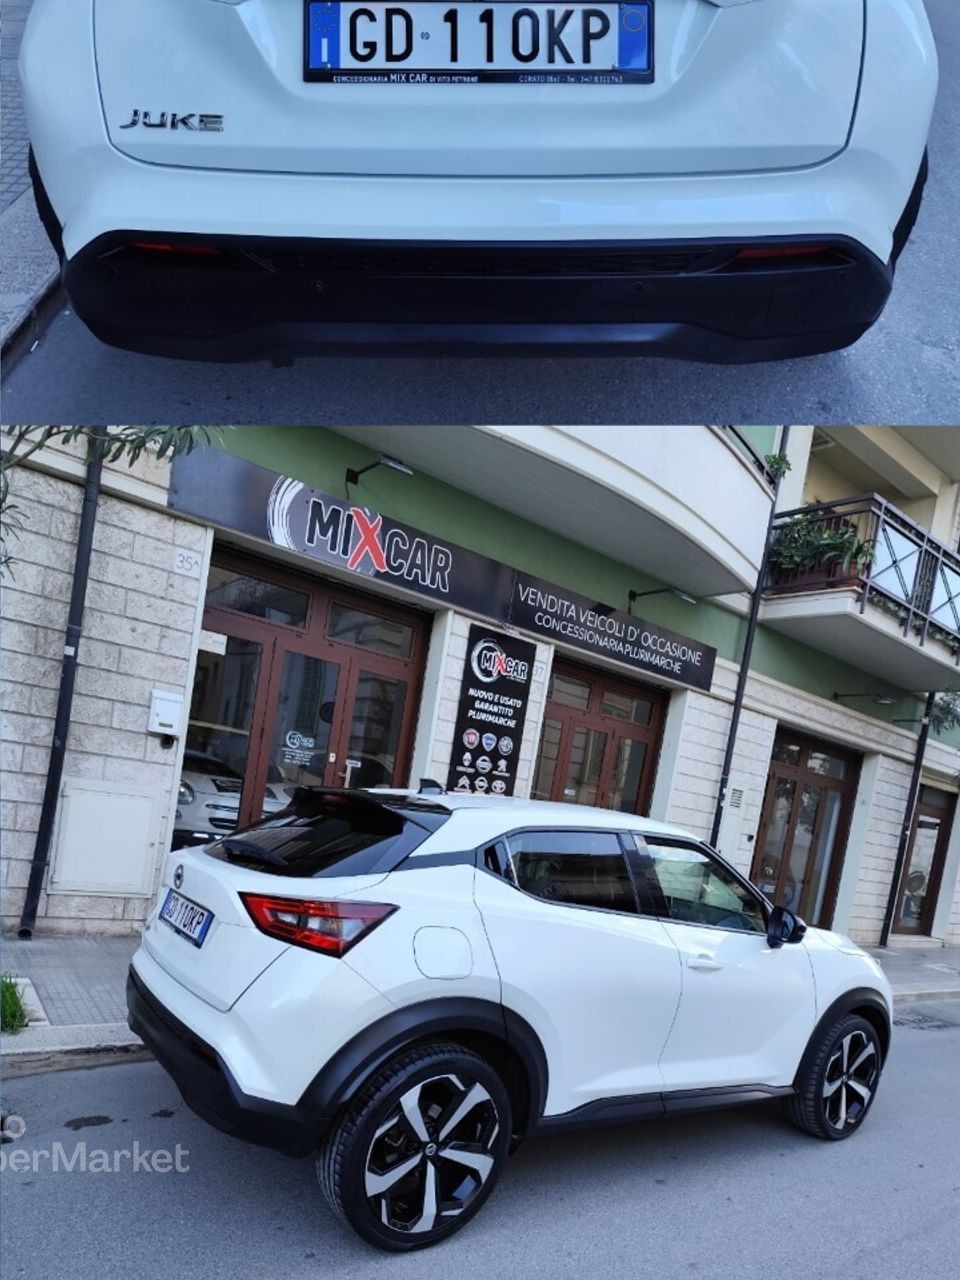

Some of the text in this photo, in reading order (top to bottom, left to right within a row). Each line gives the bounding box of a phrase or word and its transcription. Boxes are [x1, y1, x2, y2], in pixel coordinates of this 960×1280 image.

[390, 73, 407, 83] MIX
[409, 73, 428, 83] CAR
[119, 108, 224, 132] JUKE
[305, 497, 452, 593] MIXCAR
[518, 584, 576, 620] VENDITA
[579, 608, 625, 638] VEICOLI
[641, 631, 703, 667] OCCASIONE
[534, 612, 683, 675] CONCESSIONARIA PLURIMARCHE
[481, 650, 529, 680] MIXCAR
[468, 687, 522, 708] NUOVO E USATO
[474, 700, 513, 717] GARANTITO
[468, 709, 517, 728] PLURIMARCHE
